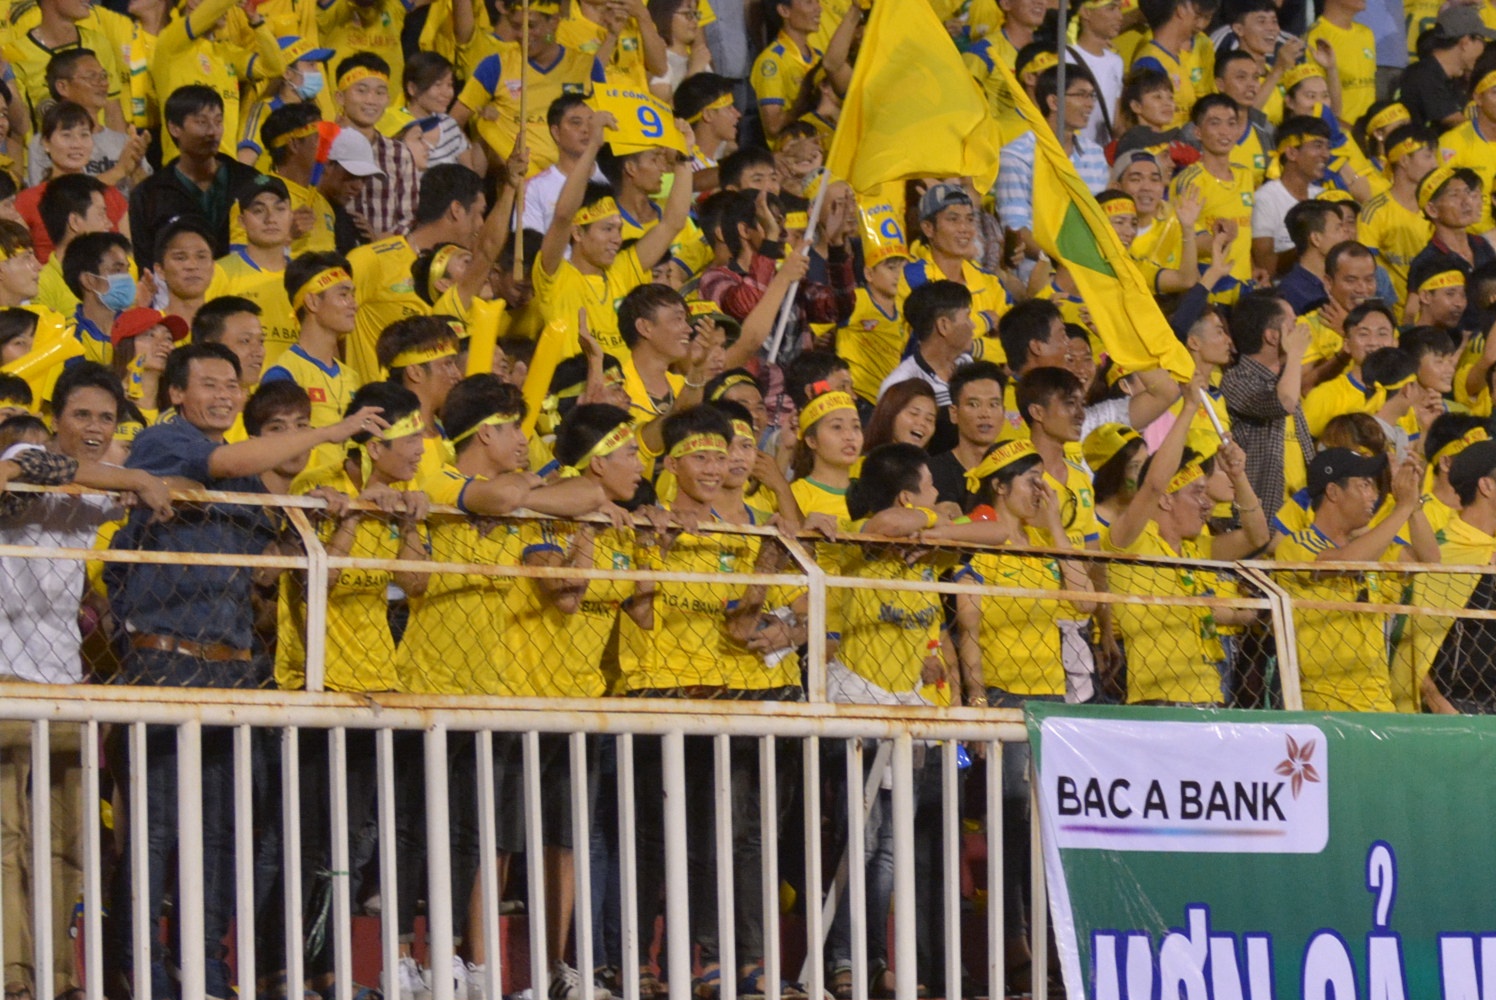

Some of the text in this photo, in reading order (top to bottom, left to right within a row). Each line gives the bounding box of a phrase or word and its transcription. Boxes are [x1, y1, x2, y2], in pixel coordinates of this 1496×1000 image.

[637, 106, 664, 138] 9
[880, 218, 905, 245] 9
[990, 440, 1026, 465] SÔNG LAM
[1057, 775, 1287, 822] BAC A BANK
